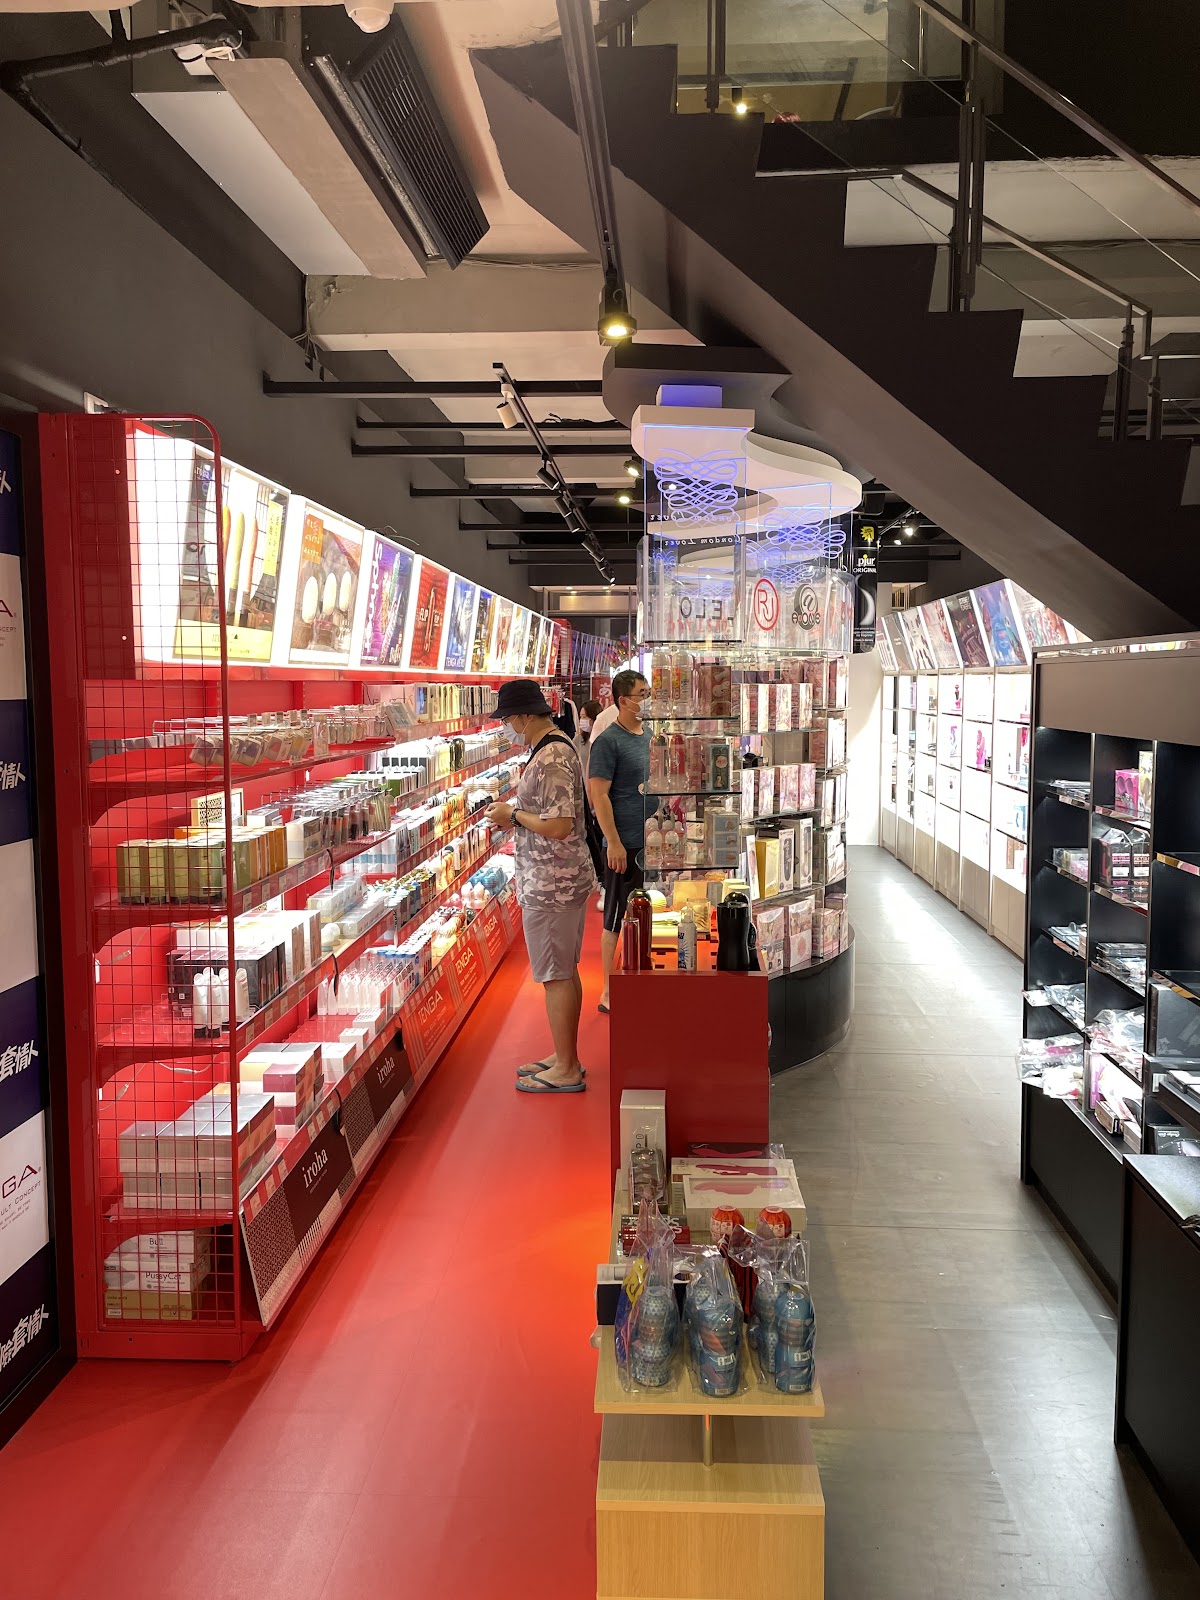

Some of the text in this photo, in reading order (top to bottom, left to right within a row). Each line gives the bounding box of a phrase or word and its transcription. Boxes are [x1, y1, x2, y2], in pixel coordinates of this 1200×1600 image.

[858, 554, 876, 567] pjur
[0, 760, 26, 790] 情人
[418, 990, 443, 1025] TENGA
[376, 1056, 395, 1084] iroha
[302, 1149, 328, 1189] iroha
[14, 1181, 41, 1205] CONCEPT
[145, 1272, 182, 1281] PussyCat
